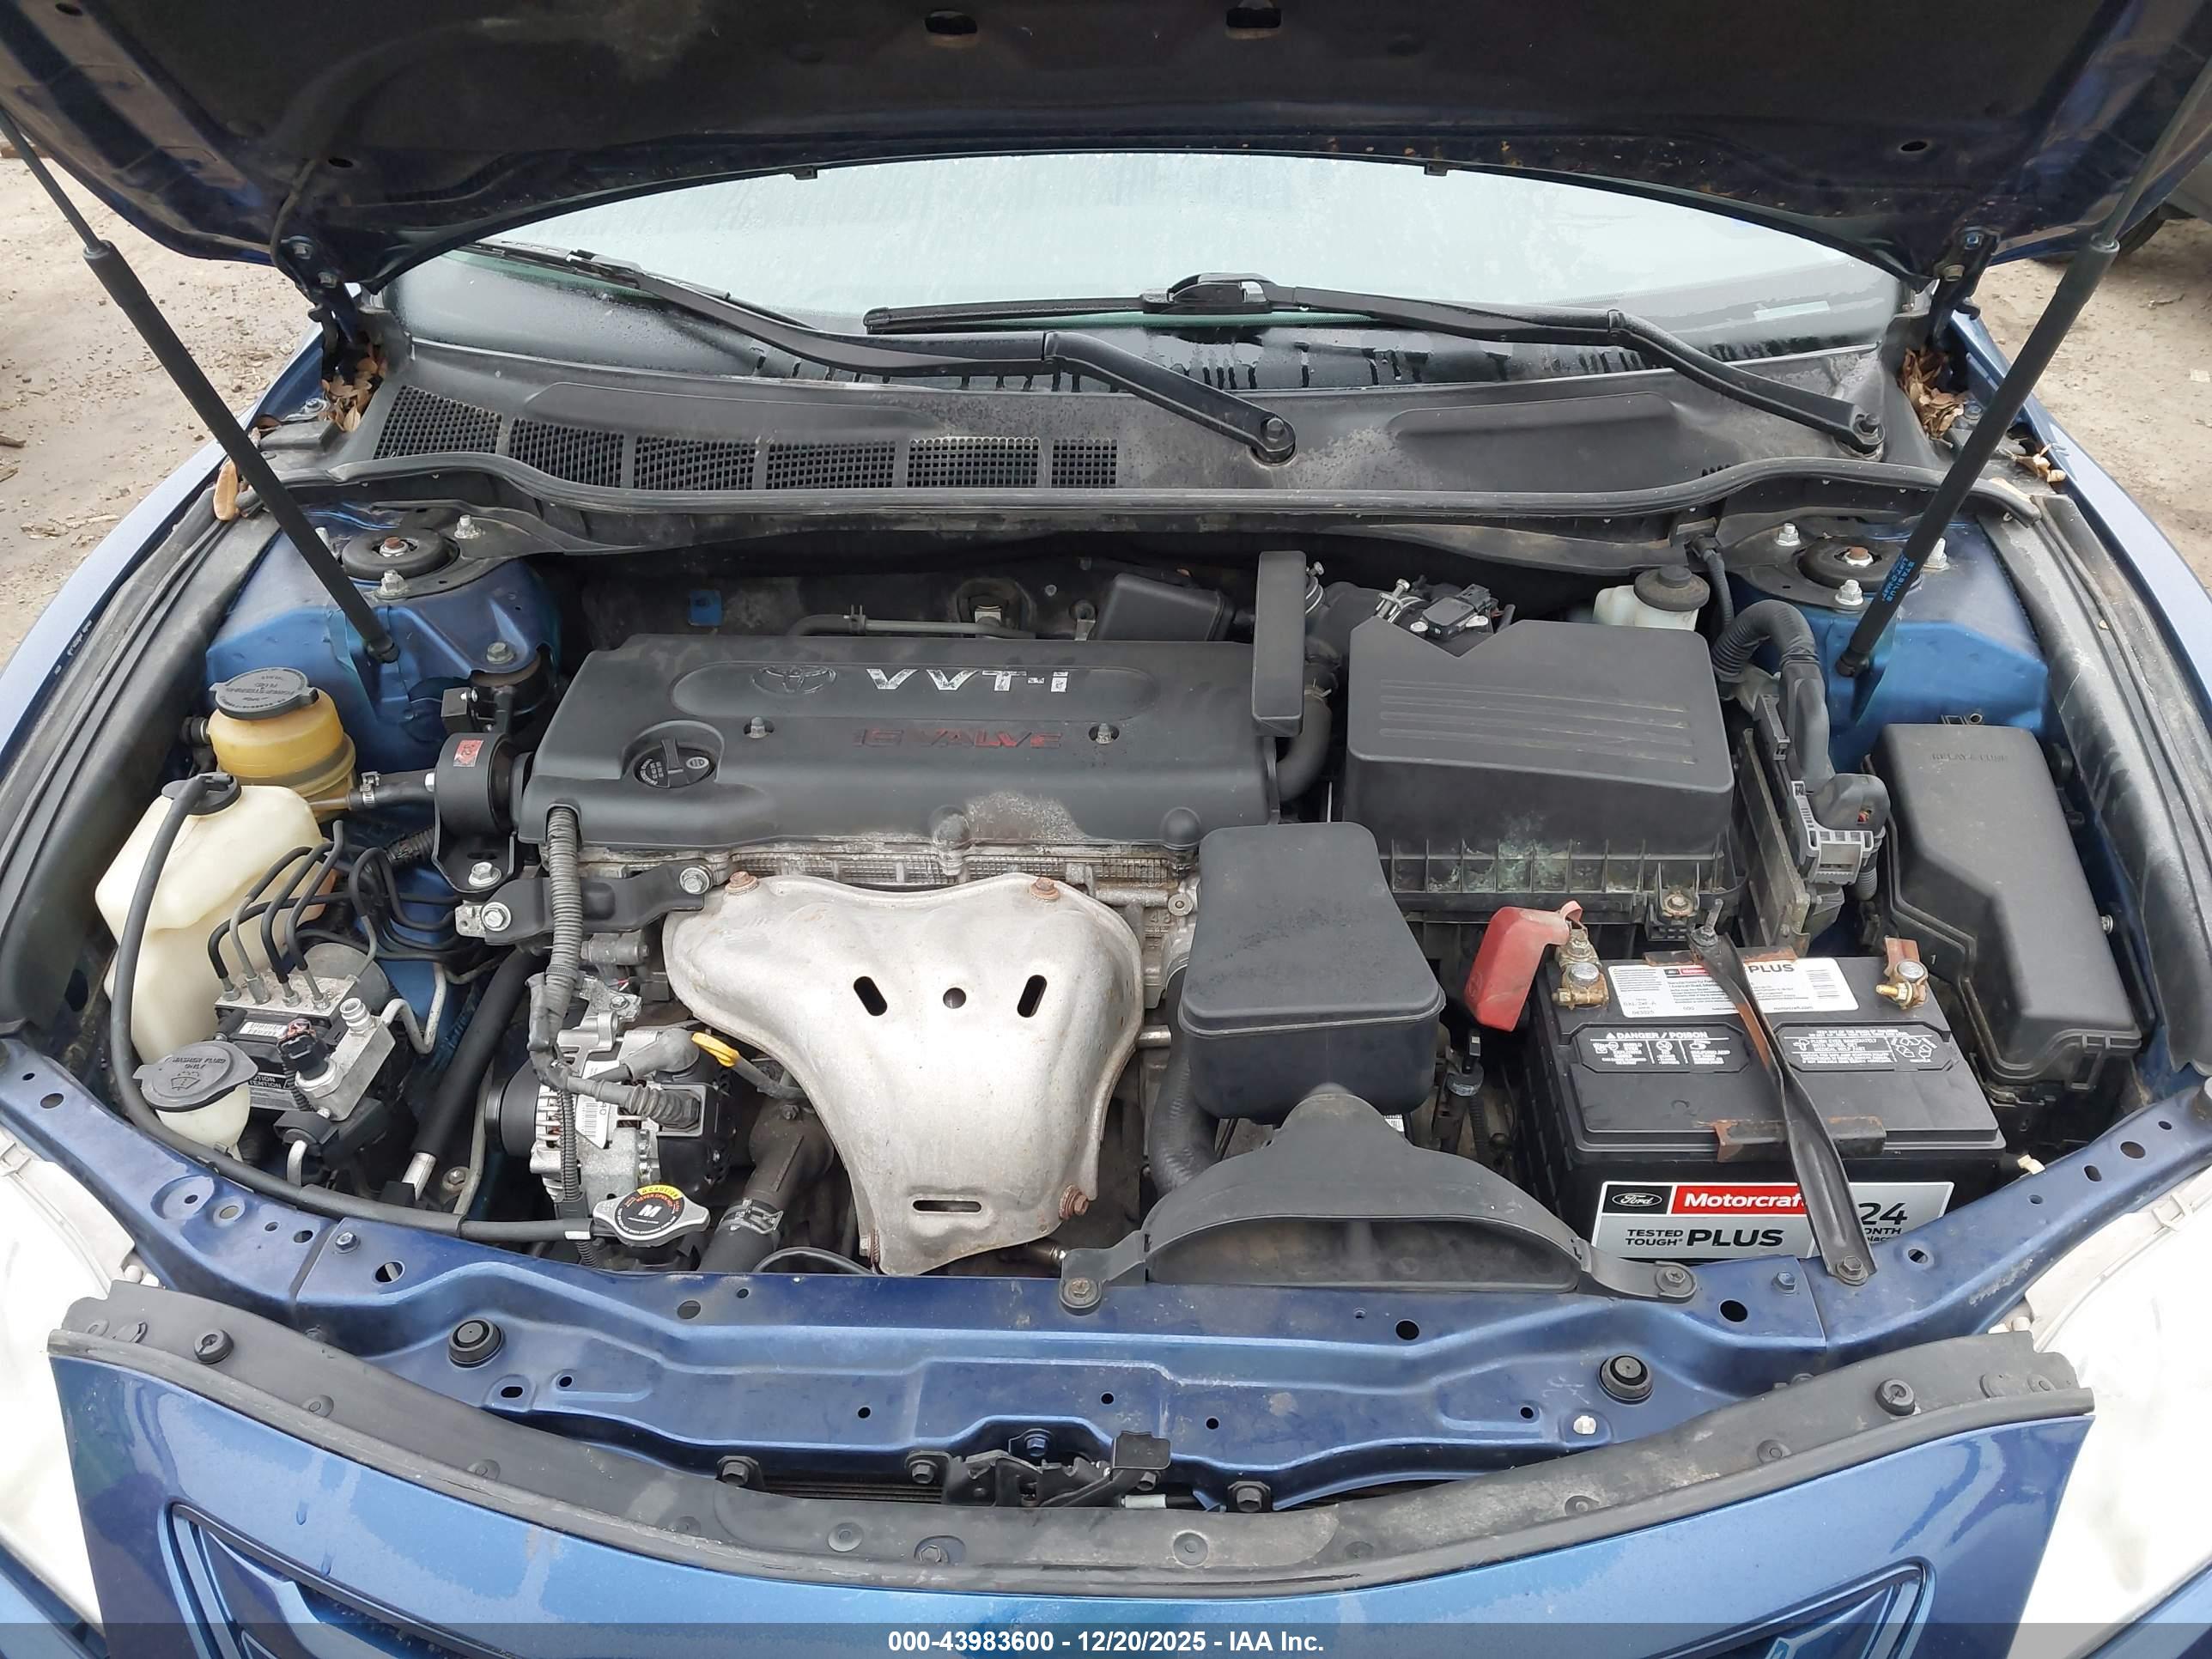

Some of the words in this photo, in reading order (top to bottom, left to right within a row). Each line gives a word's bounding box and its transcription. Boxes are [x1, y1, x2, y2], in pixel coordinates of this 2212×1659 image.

[910, 729, 1062, 749] VALVE
[1748, 963, 1795, 973] PLUS
[648, 1186, 679, 1198] CAUTION
[1620, 1194, 1654, 1206] Ford
[1684, 1192, 1805, 1208] Motorcraf
[637, 1204, 663, 1218] M
[1857, 1202, 1908, 1225] 24
[1627, 1229, 1684, 1237] TESTED
[1686, 1229, 1785, 1247] PLUS
